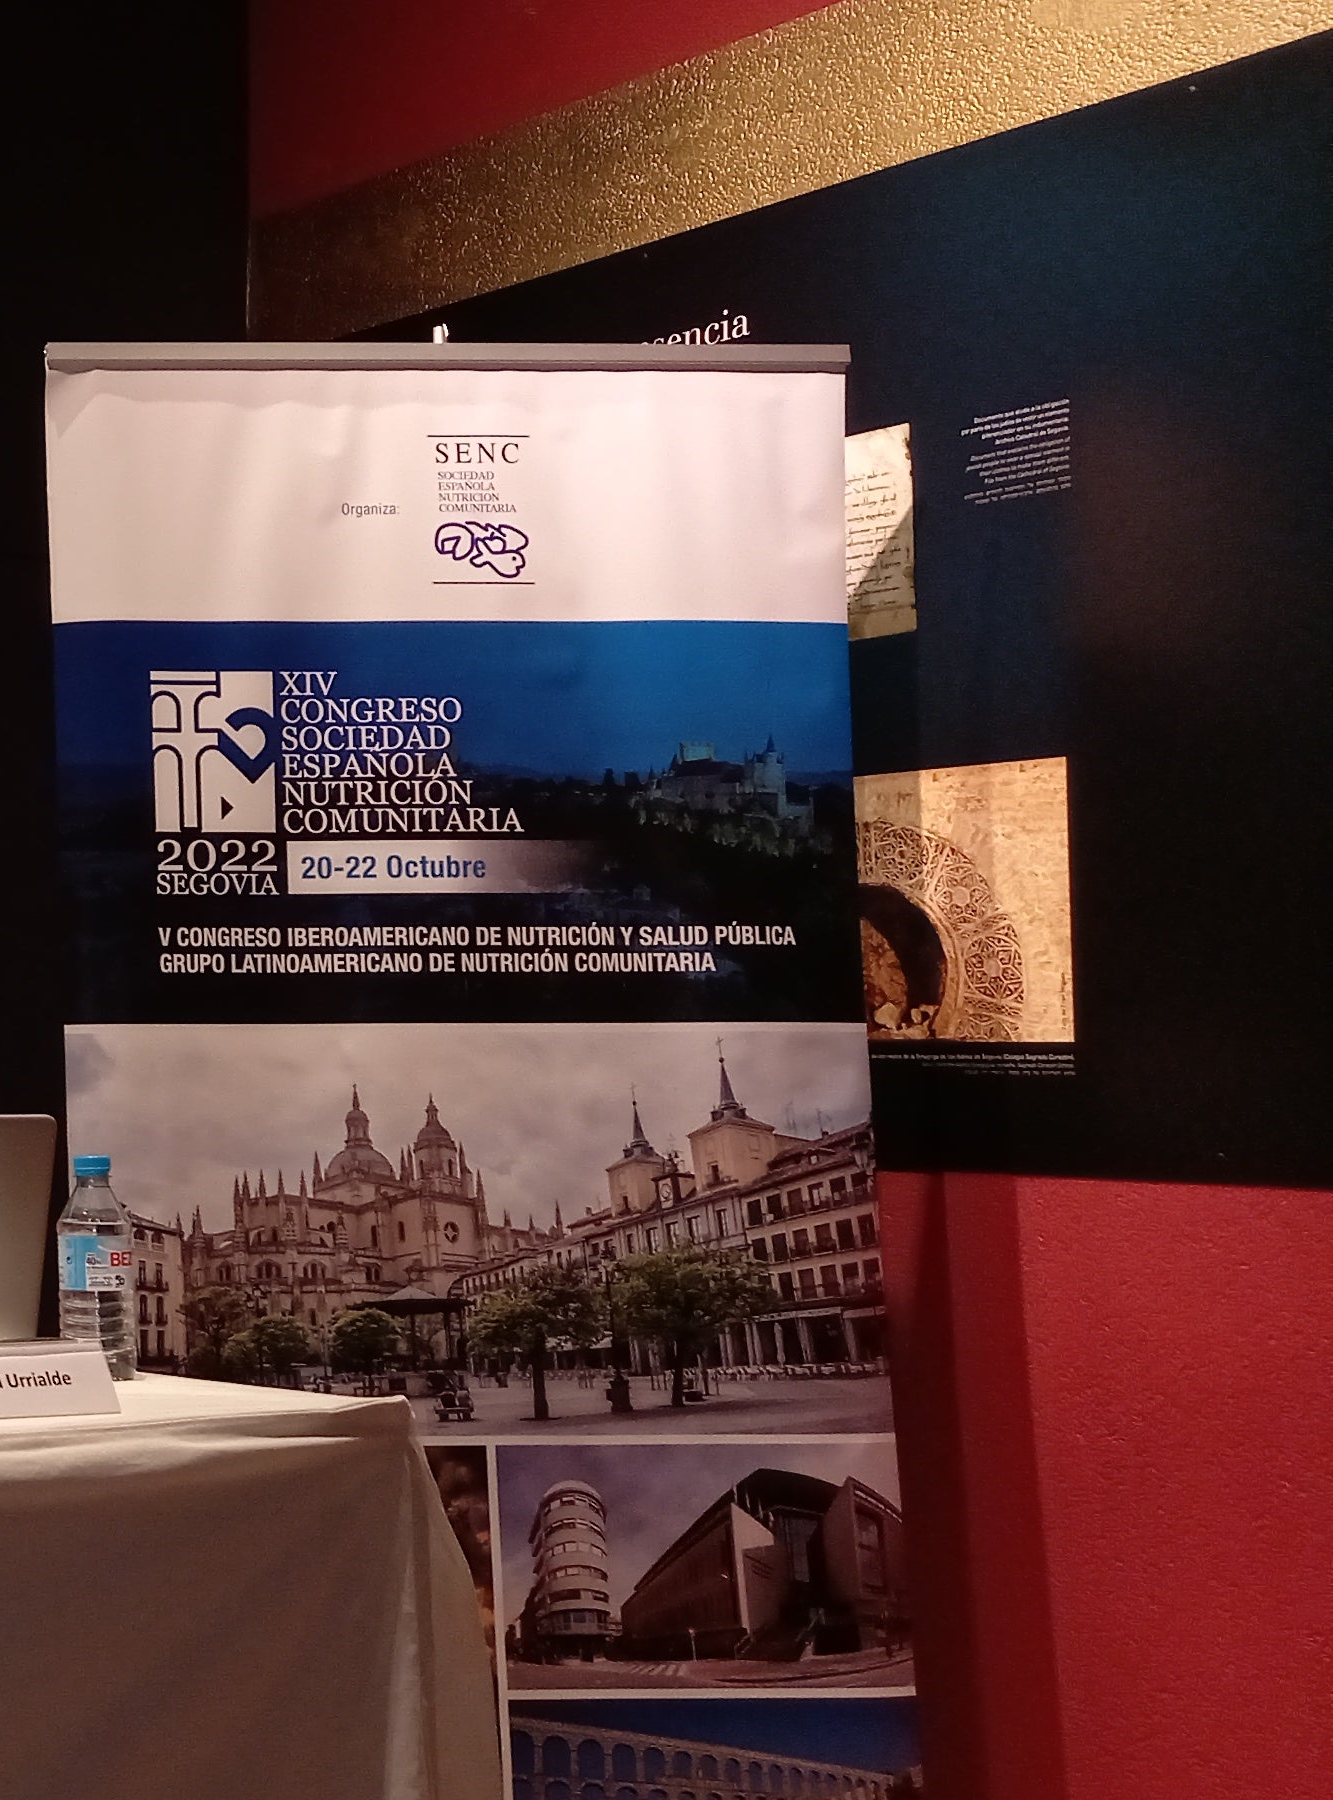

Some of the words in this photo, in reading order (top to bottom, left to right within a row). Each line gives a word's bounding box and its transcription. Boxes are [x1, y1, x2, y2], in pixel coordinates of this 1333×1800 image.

[435, 443, 519, 464] SENC
[438, 471, 494, 480] SOCIEDAD
[438, 481, 495, 491] ESPAÑOLA
[341, 503, 400, 517] Organiza:
[439, 504, 517, 513] COMUNITARIA
[279, 671, 338, 696] XIV
[280, 698, 462, 723] CONGRESO
[281, 725, 451, 751] SOCIEDAD
[282, 746, 457, 778] ESPAÑOLA
[282, 774, 473, 805] NUTRICIÓN
[283, 807, 525, 833] COMUNITARIA
[157, 839, 278, 872] 2022
[301, 855, 377, 879] 20-22
[386, 855, 486, 878] Octubre
[156, 873, 279, 895] SEGOVIA
[158, 927, 171, 947] V
[177, 927, 281, 947] CONGRESO
[287, 926, 469, 947] IBEROAMERICANO
[476, 926, 501, 946] DE
[507, 921, 614, 946] NUTRICIÓN
[620, 926, 633, 946] Y
[639, 926, 708, 946] SALUD
[714, 920, 797, 946] PÚBLICA
[159, 953, 225, 973] GRUPO
[230, 953, 423, 973] LATINOAMERICANO
[429, 953, 455, 973] DE
[461, 948, 568, 973] NUTRICIÓN
[574, 952, 717, 973] COMUNITARIA
[5, 1370, 72, 1388] Urrialde
